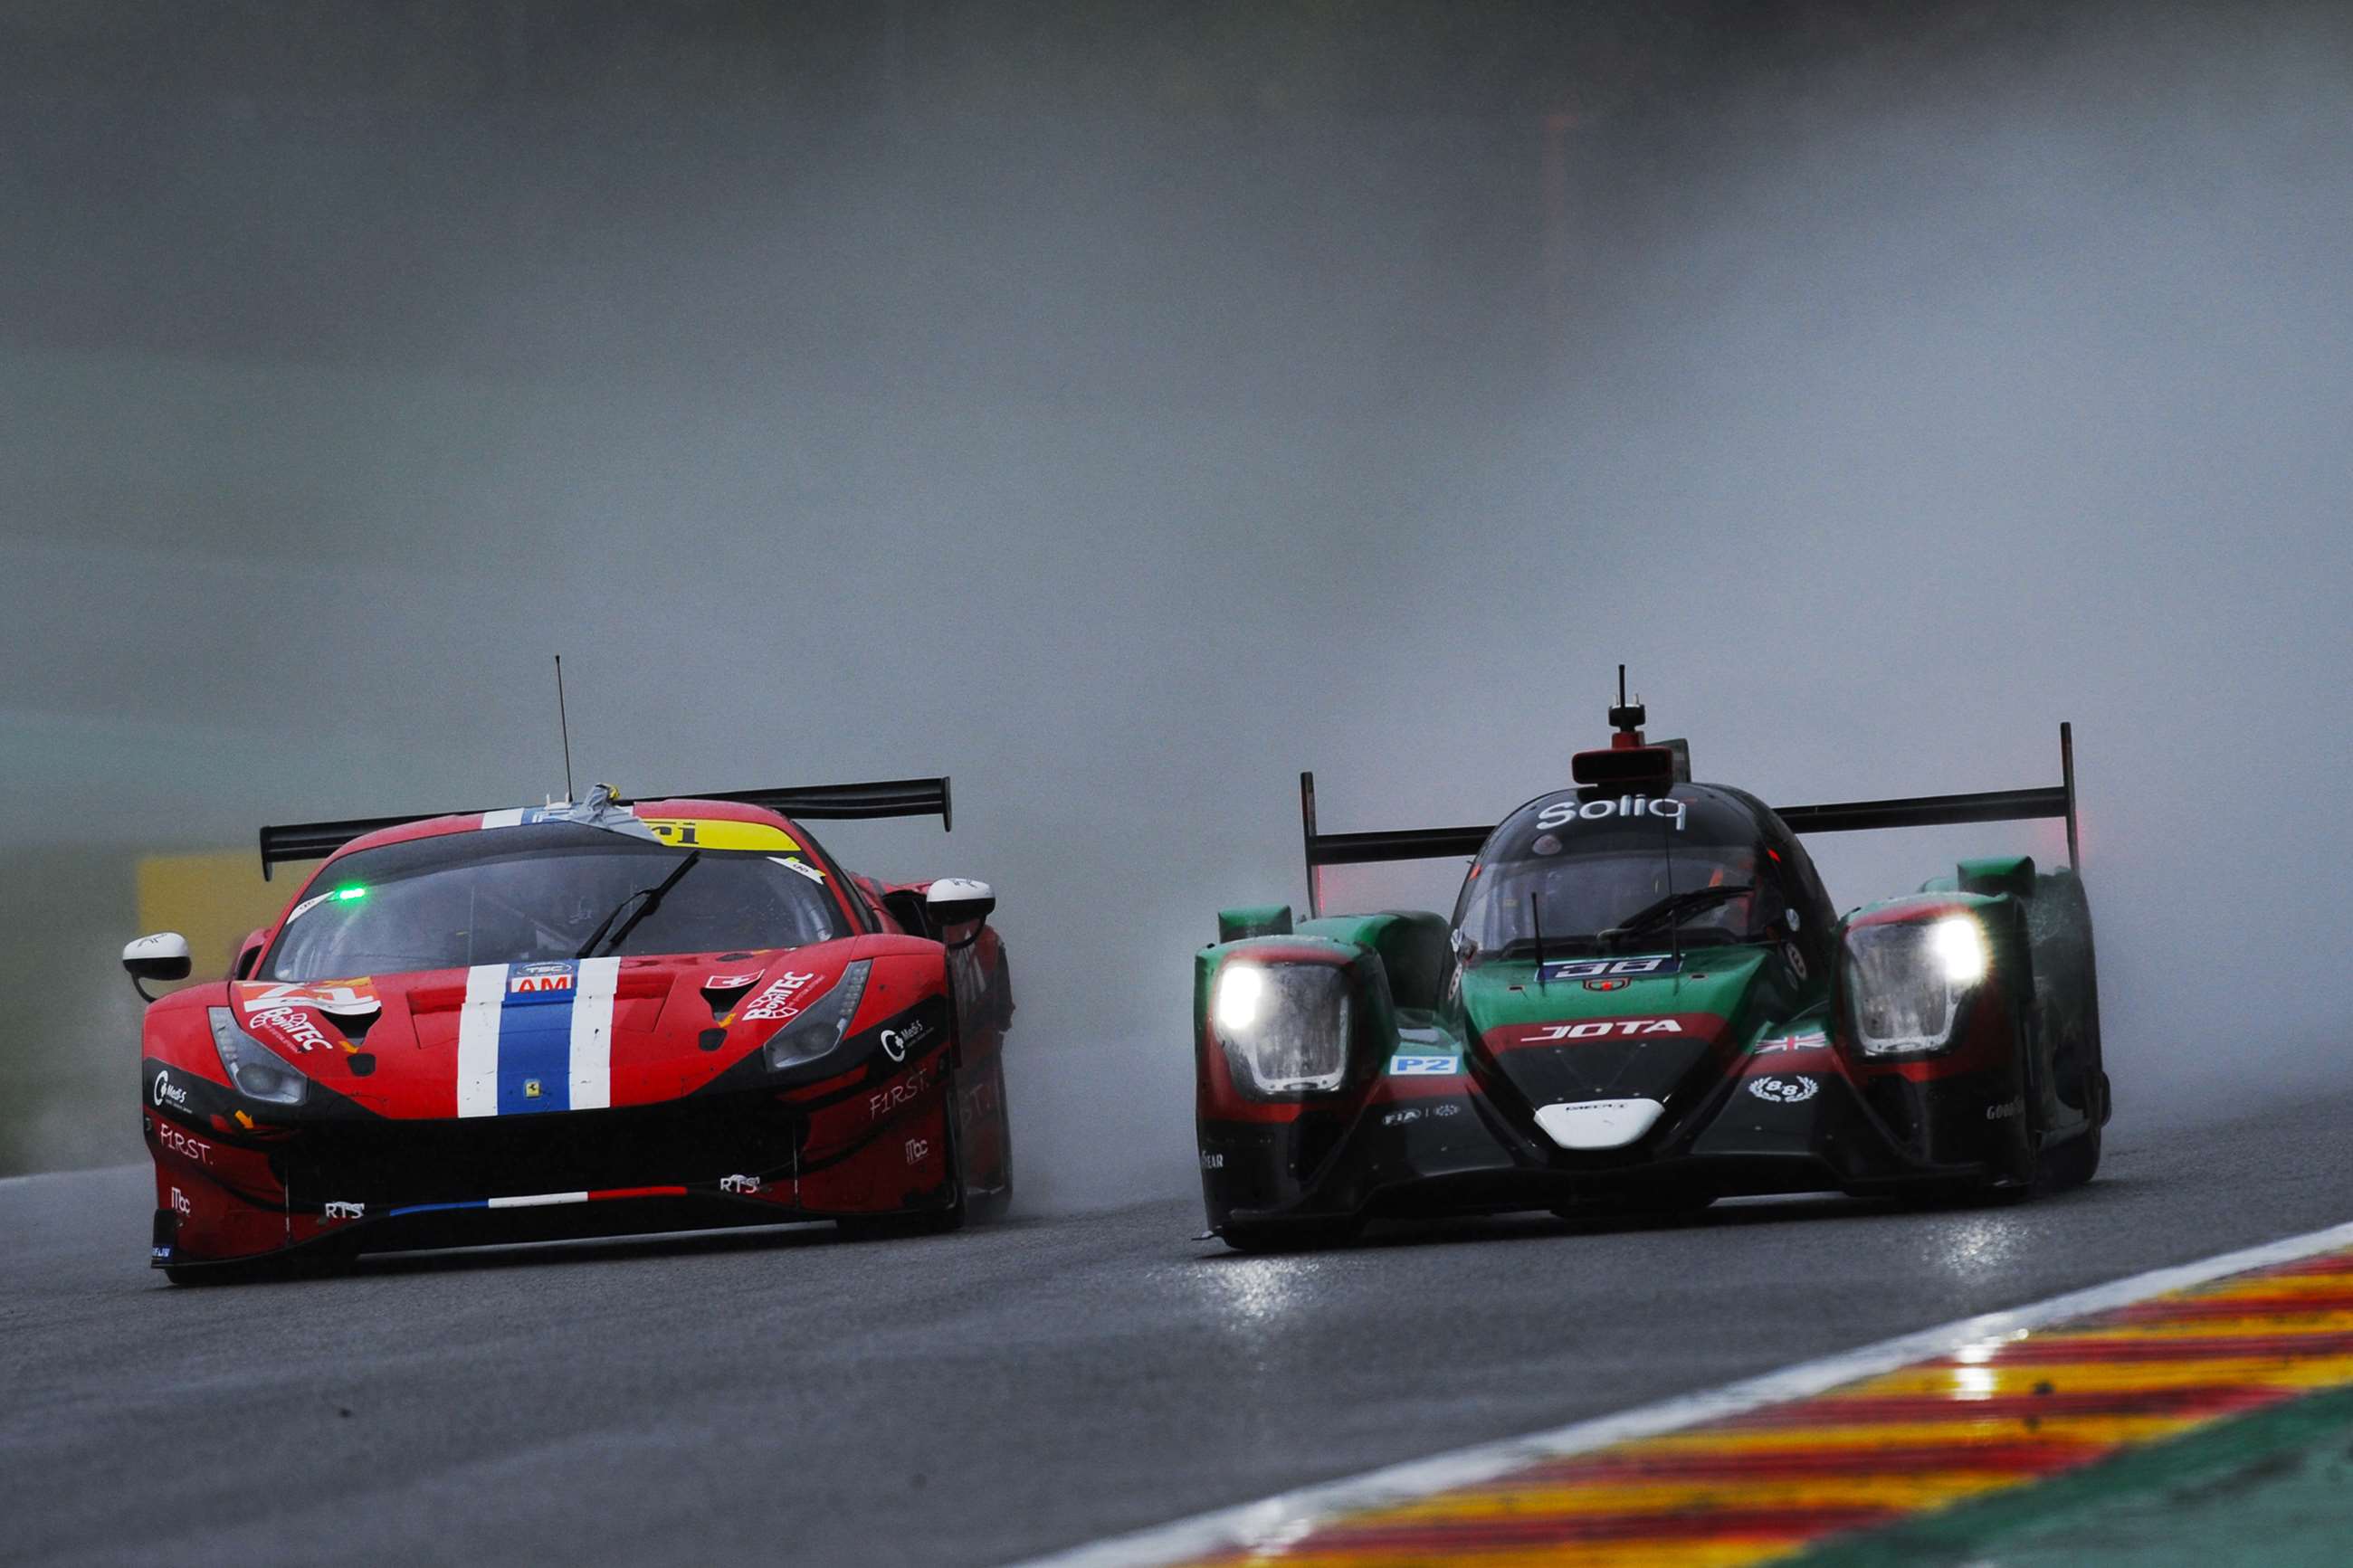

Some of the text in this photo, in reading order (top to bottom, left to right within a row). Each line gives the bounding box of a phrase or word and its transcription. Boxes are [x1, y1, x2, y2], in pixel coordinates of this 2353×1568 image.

[1537, 794, 1687, 831] Soliq
[1555, 958, 1662, 978] 38
[519, 976, 567, 993] AM
[1520, 1019, 1683, 1041] JOTA
[1397, 1059, 1451, 1071] P2
[1383, 1110, 1420, 1125] FIA
